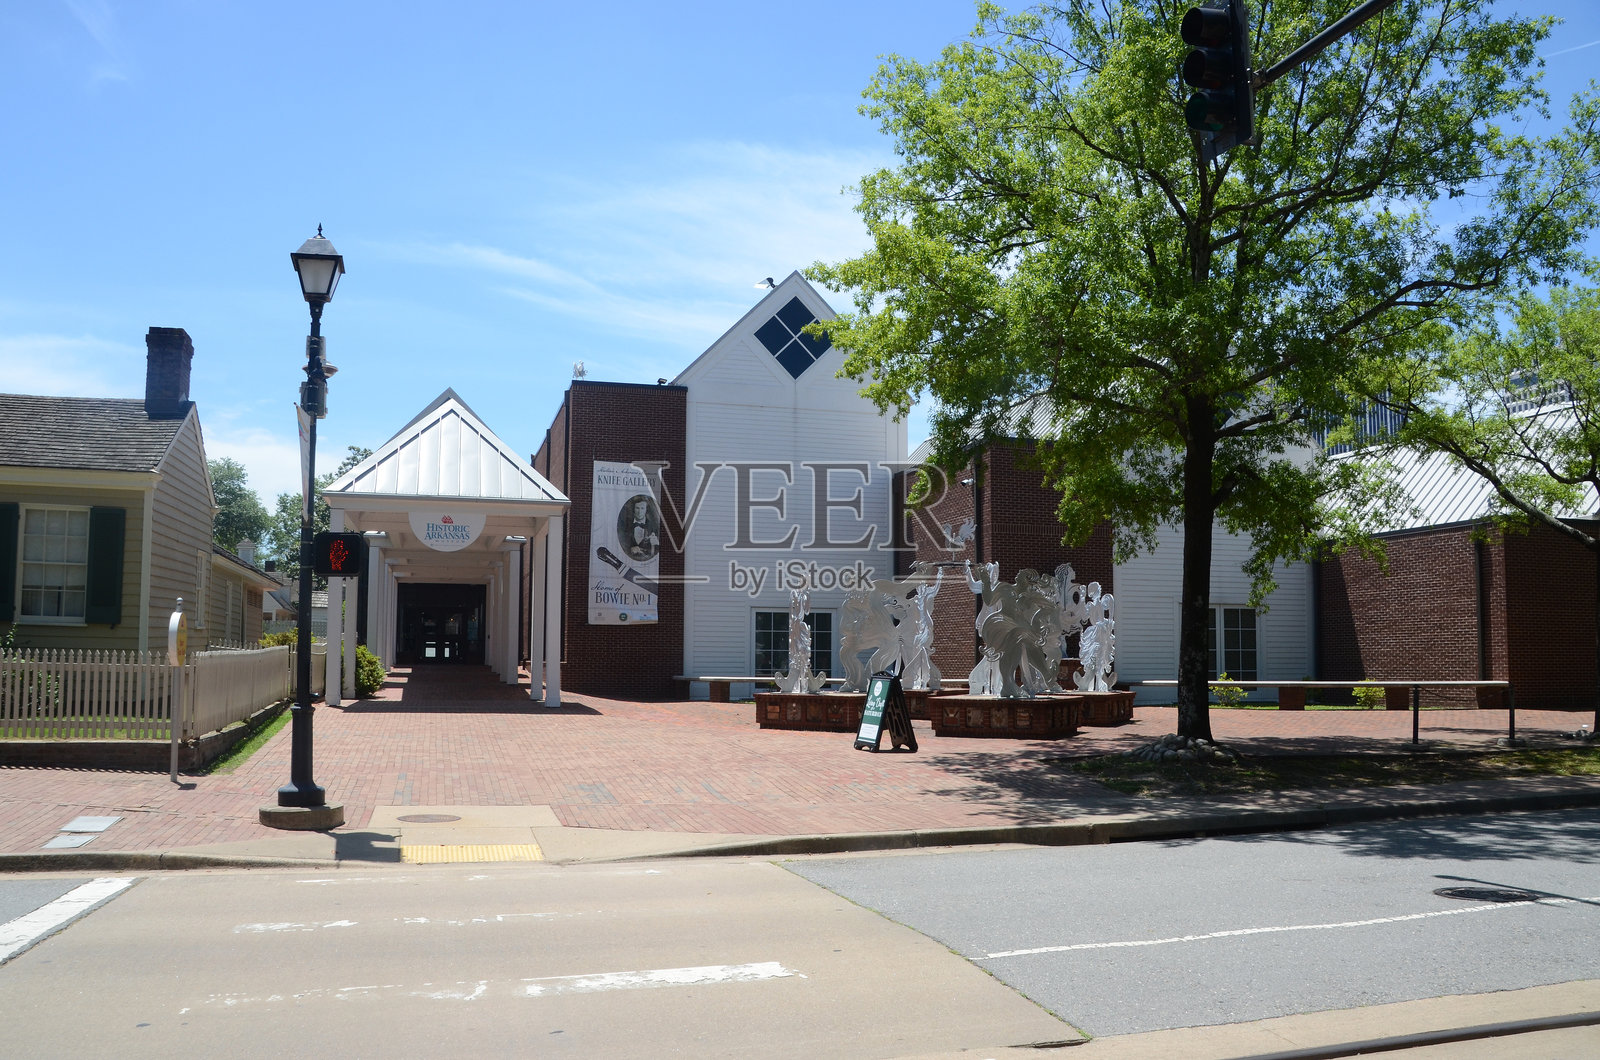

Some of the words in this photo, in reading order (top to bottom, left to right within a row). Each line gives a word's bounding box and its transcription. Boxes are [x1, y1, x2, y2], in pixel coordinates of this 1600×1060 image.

[597, 474, 621, 485] KNIFE
[623, 476, 656, 488] GALLERY
[426, 523, 470, 532] HISTORIC
[424, 532, 470, 540] ARKANSAS
[591, 580, 614, 591] Home
[615, 584, 625, 595] of
[595, 591, 630, 605] BOWIE
